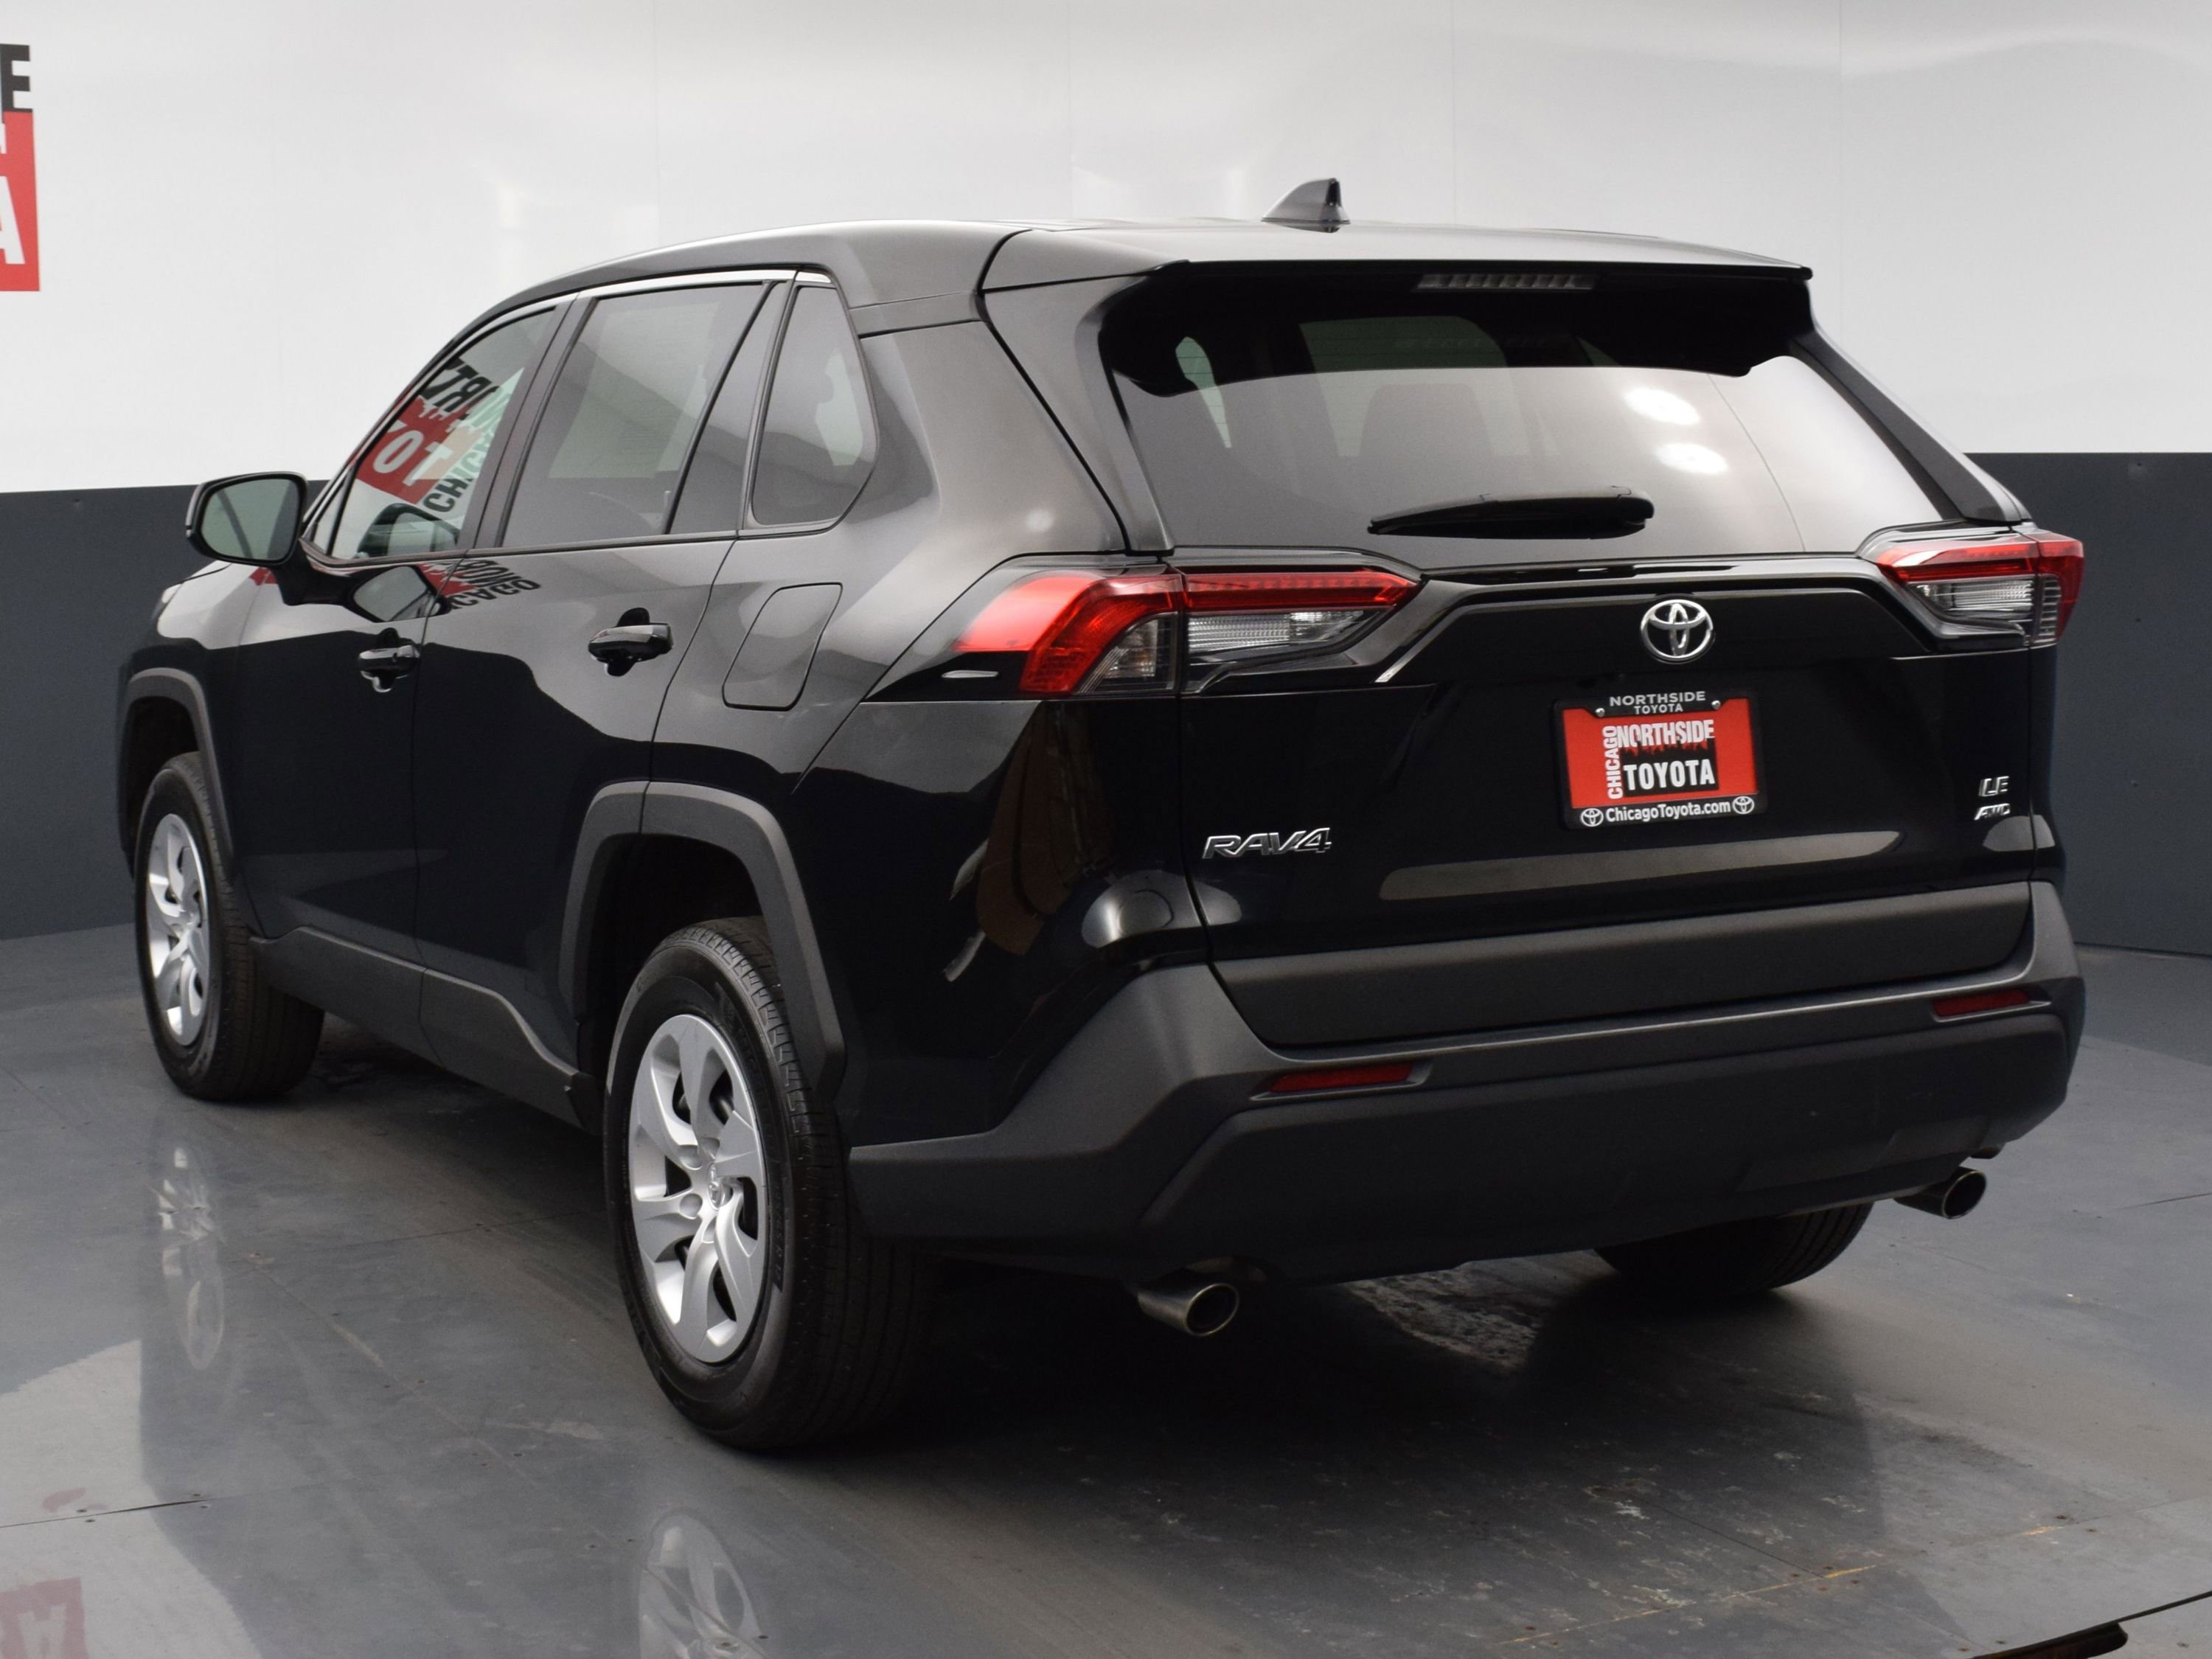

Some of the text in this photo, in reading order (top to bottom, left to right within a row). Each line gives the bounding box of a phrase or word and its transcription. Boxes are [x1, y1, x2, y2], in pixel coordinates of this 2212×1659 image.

[1610, 691, 1705, 706] NORTHSIDE
[1634, 703, 1683, 714] TOYOTA
[1617, 719, 1715, 748] NORTHSIDE
[1602, 726, 1624, 799] CHICAGO
[1624, 759, 1716, 790] TOYOTA
[1978, 776, 2009, 796] LE
[1606, 801, 1731, 822] ChicagoToyota.com
[1202, 827, 1332, 859] RAV4
